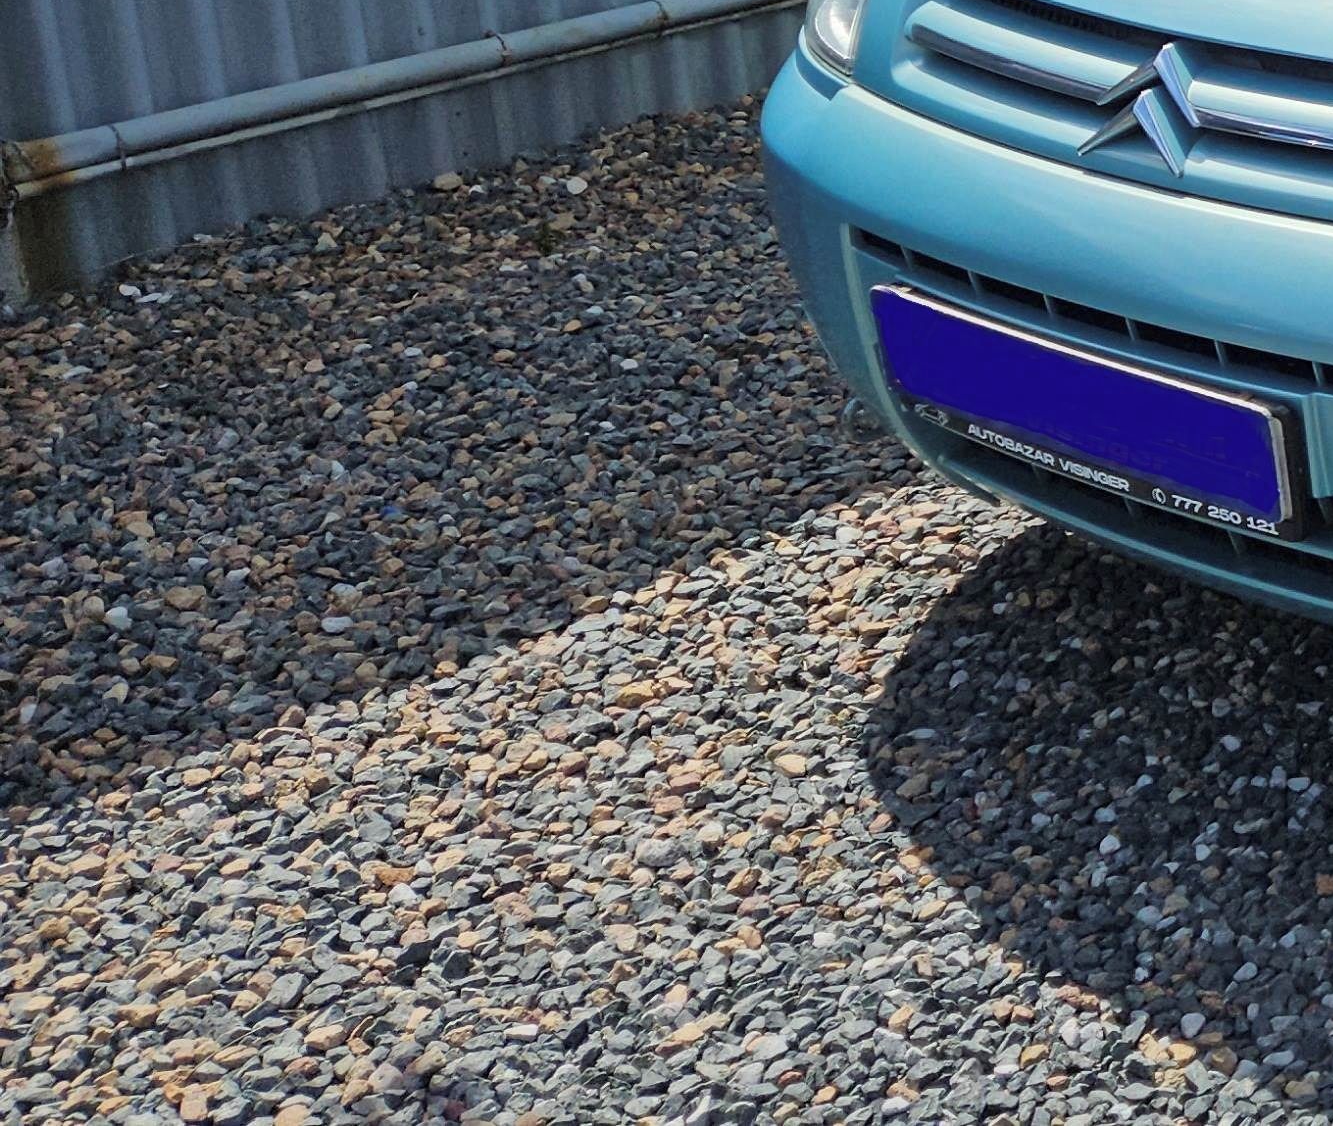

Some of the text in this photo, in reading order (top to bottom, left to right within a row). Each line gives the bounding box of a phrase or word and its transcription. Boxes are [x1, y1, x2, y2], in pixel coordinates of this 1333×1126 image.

[968, 424, 1279, 535] AUTOBAZAR VISINGER 777 250 121
